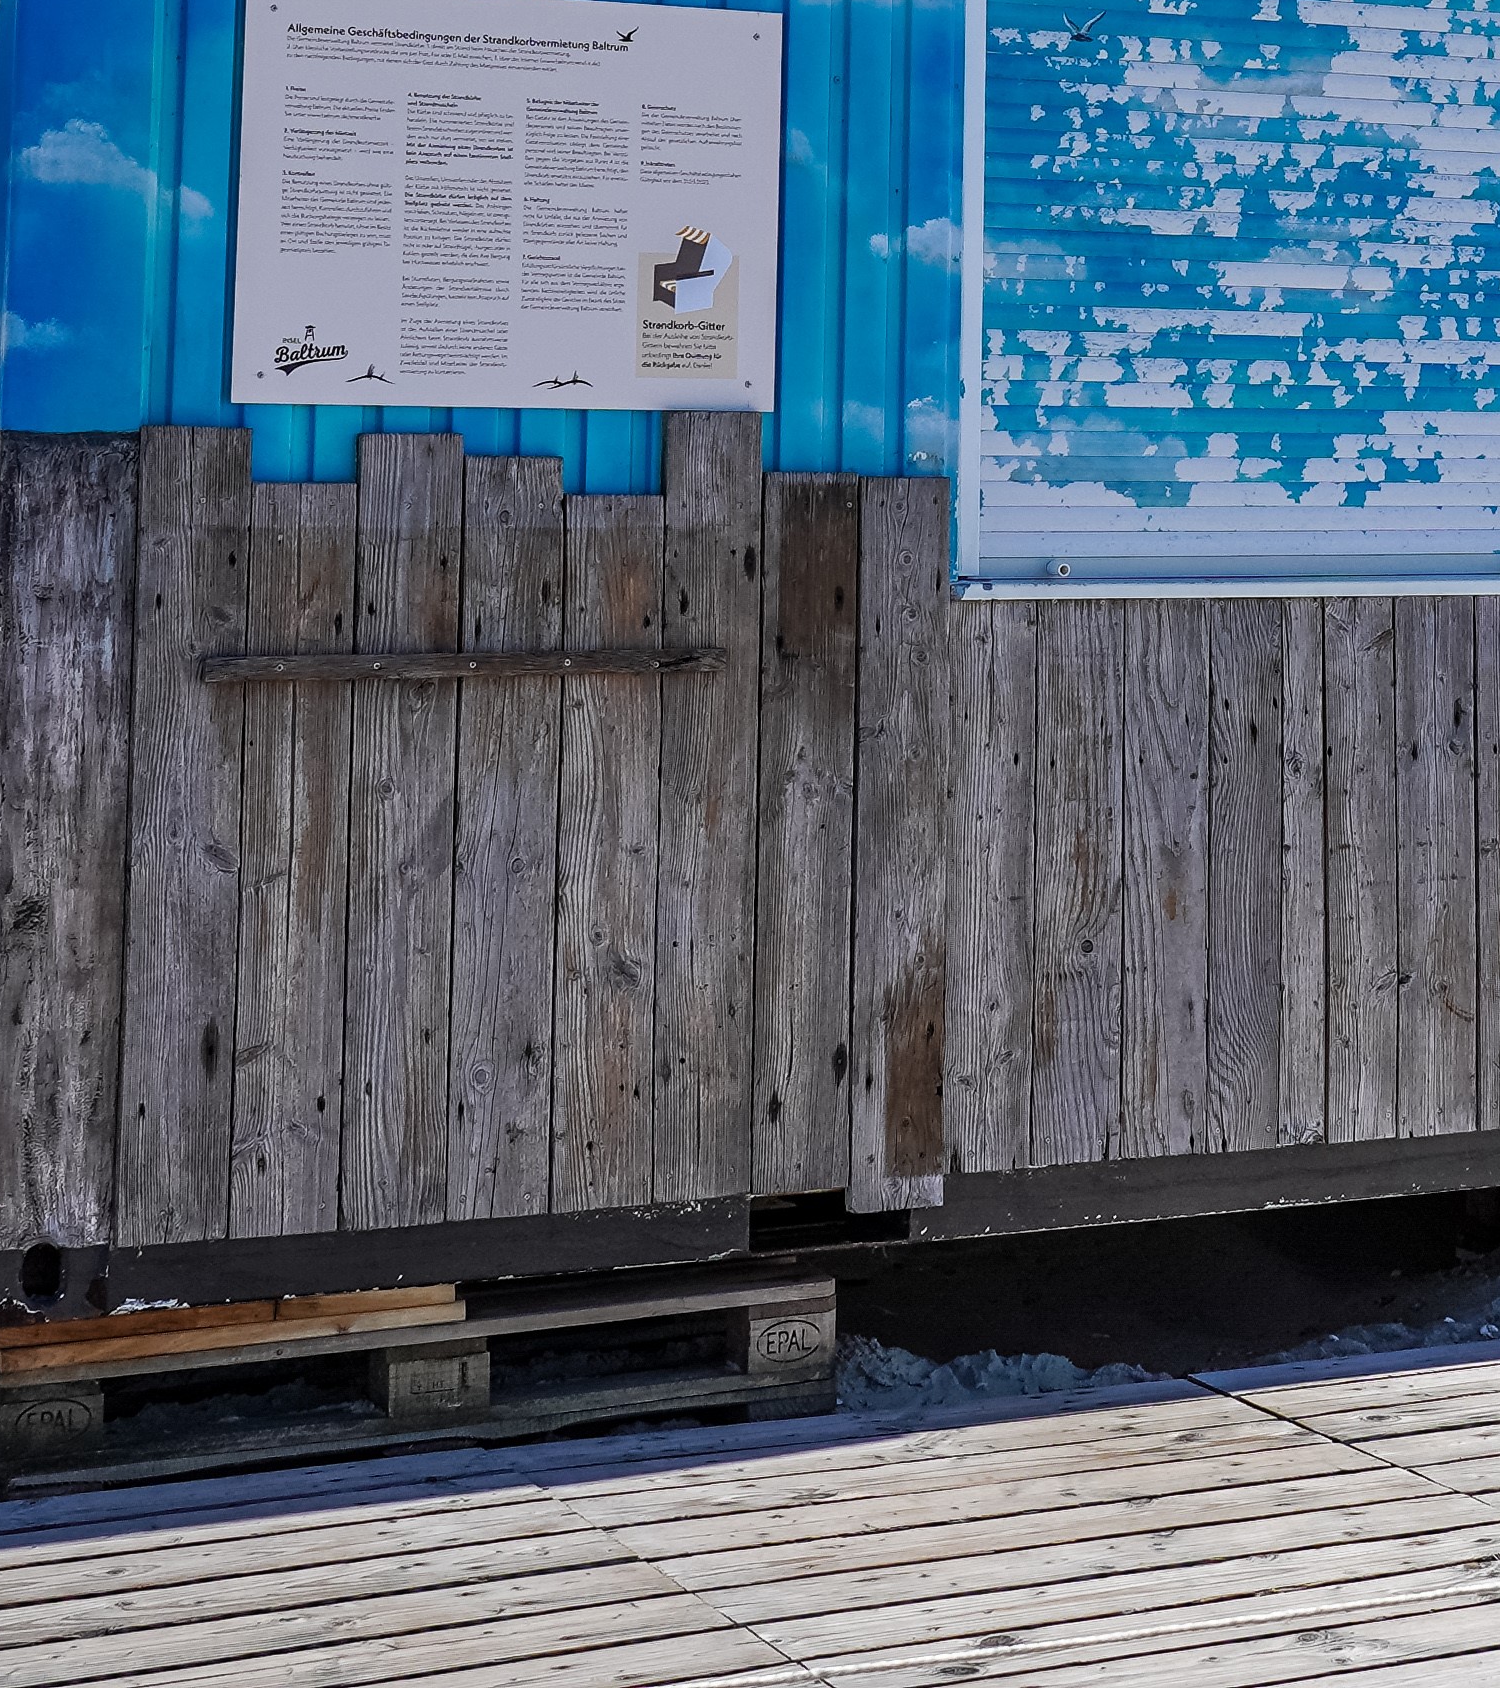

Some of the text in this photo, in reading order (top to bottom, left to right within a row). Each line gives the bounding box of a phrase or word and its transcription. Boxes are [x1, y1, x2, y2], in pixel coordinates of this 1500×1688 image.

[287, 23, 629, 52] Allgemeine Geschäftsbedingungen der Strandkorbvermietung Baltrum
[642, 319, 726, 331] Strandkorb-Gitter
[274, 343, 346, 364] Baltrum
[766, 1328, 812, 1354] EPAL
[26, 1408, 80, 1433] EPAL
